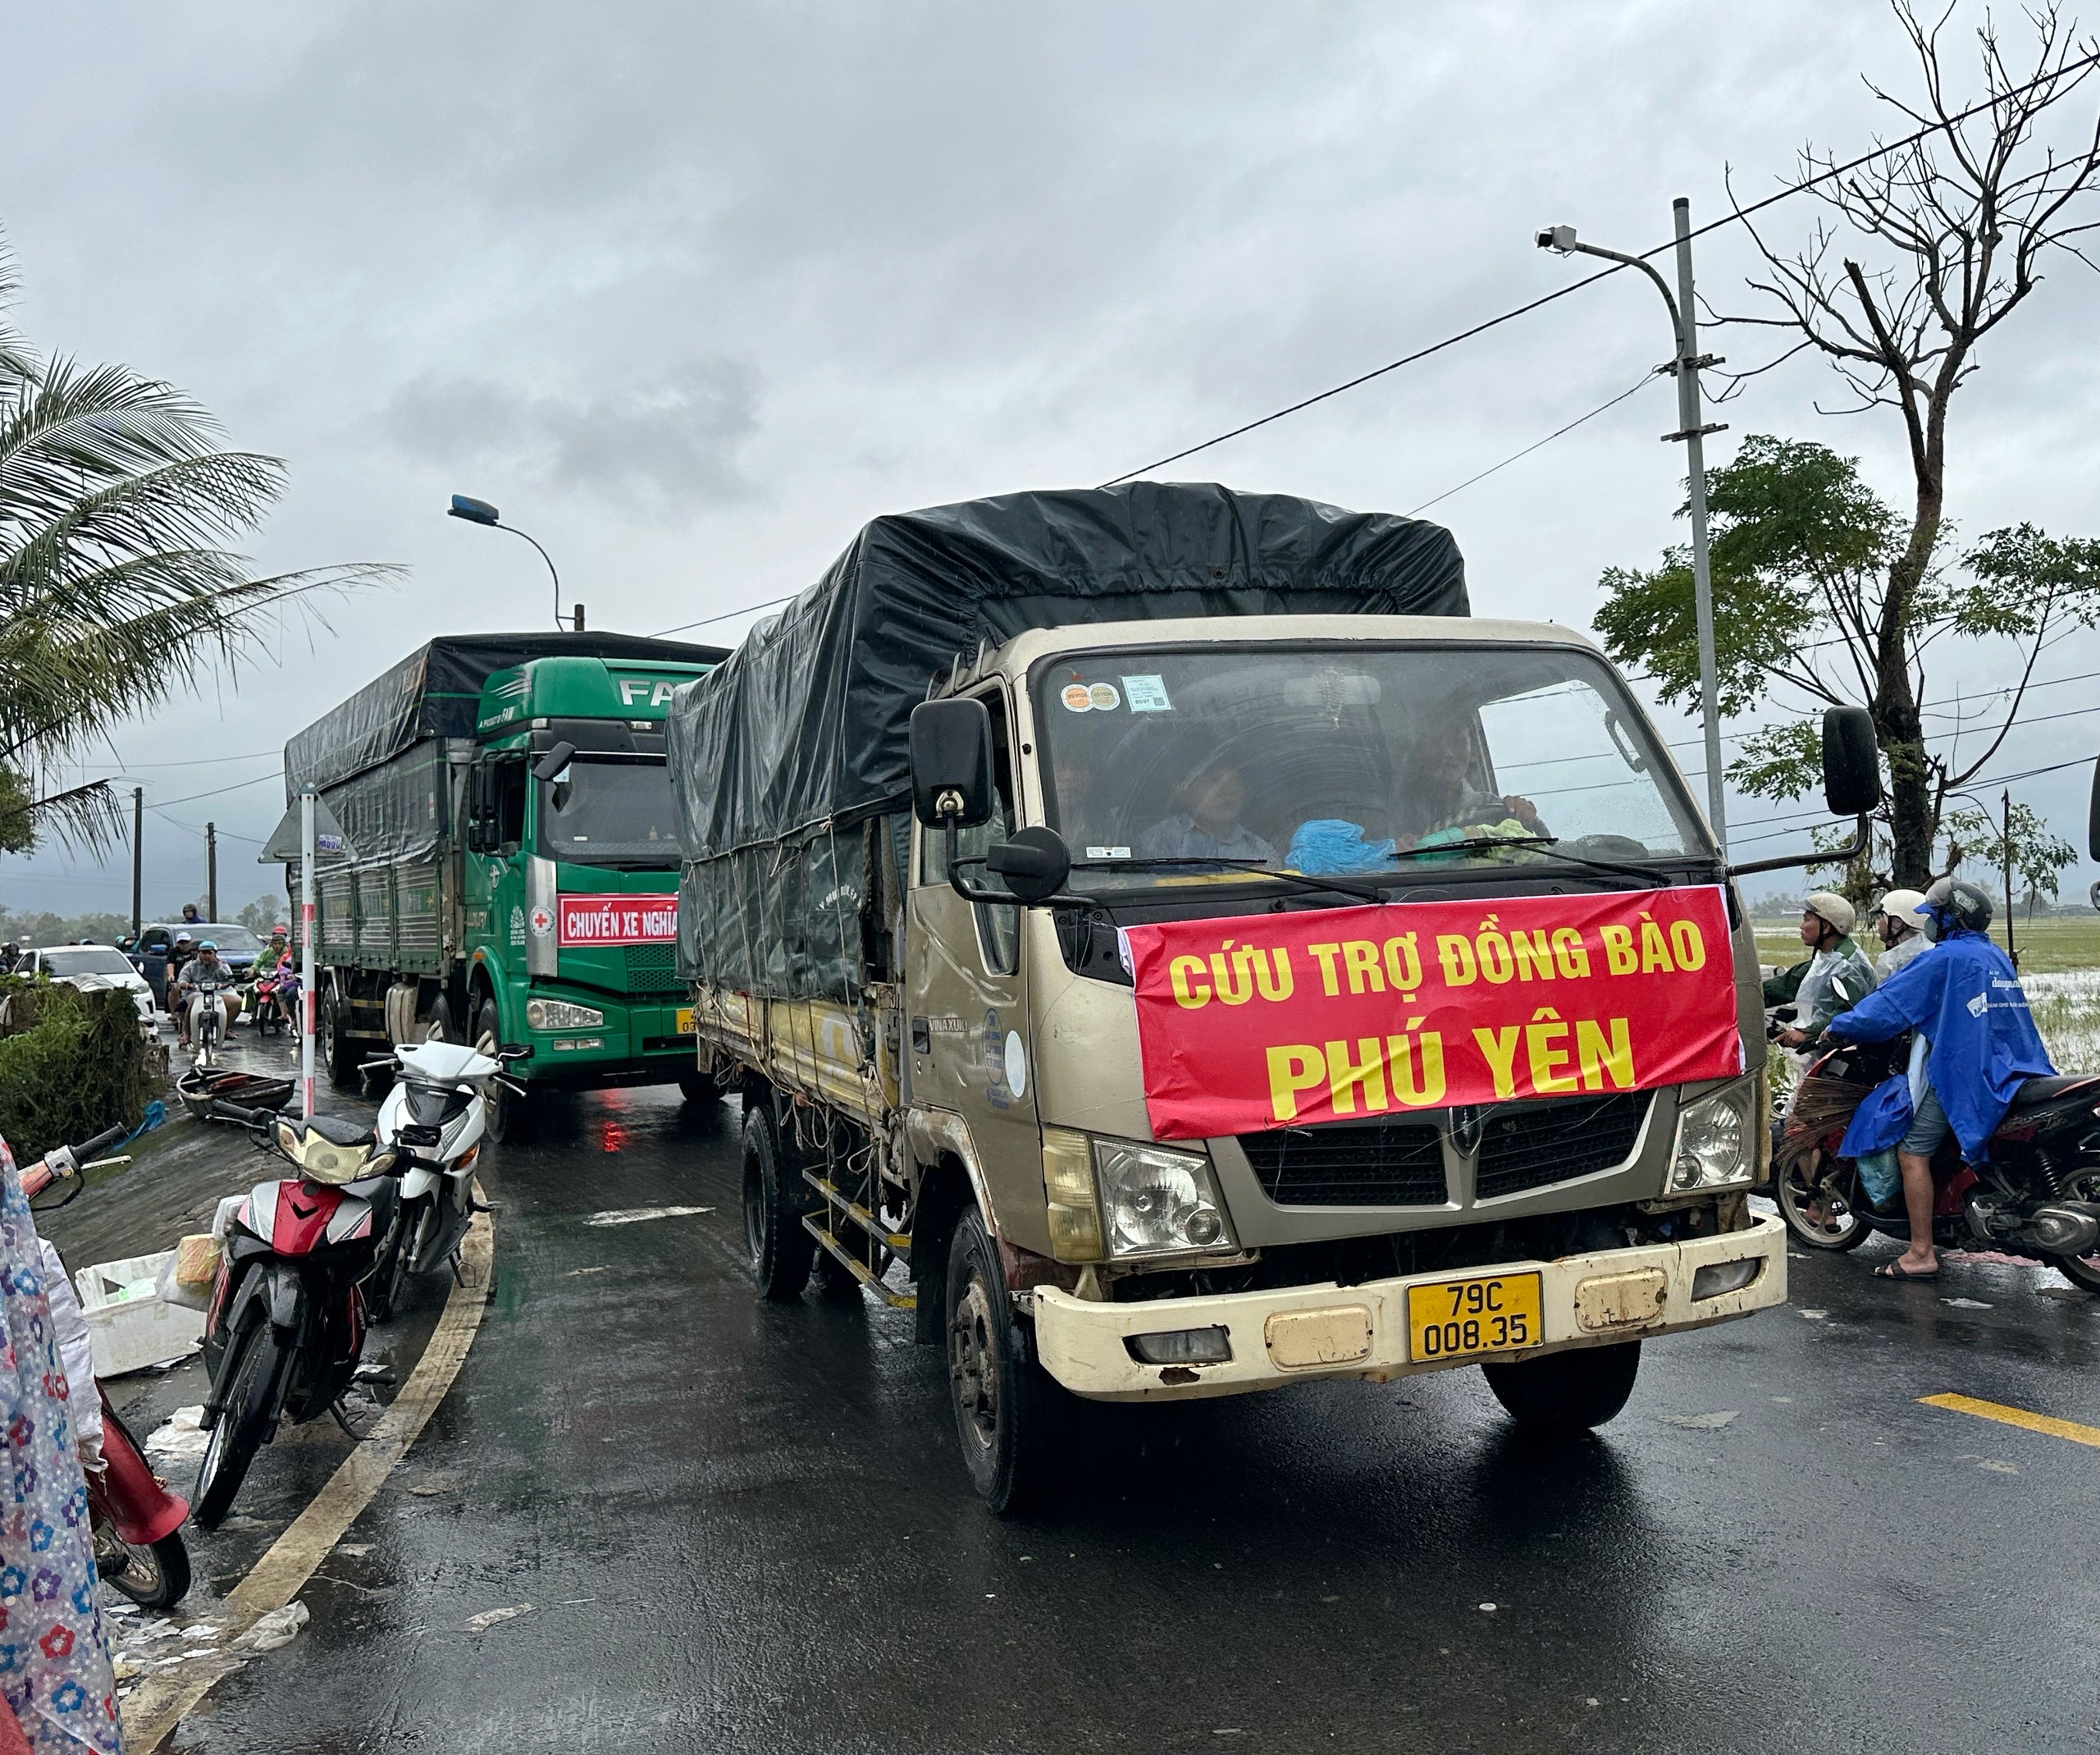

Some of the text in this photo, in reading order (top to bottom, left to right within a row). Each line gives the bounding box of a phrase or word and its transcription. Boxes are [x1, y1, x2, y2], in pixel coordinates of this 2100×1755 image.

[619, 679, 679, 707] FA
[501, 706, 516, 723] FAW
[567, 902, 619, 938] CHUYẾN
[622, 912, 639, 937] XE
[1169, 911, 1706, 1010] CỨU TRỢ ĐỒNG BÀO
[929, 1018, 968, 1032] VINAXUKI
[1265, 1007, 1637, 1122] PHÚ YÊN
[1447, 1281, 1504, 1317] 79C
[1424, 1313, 1527, 1355] 008.35
